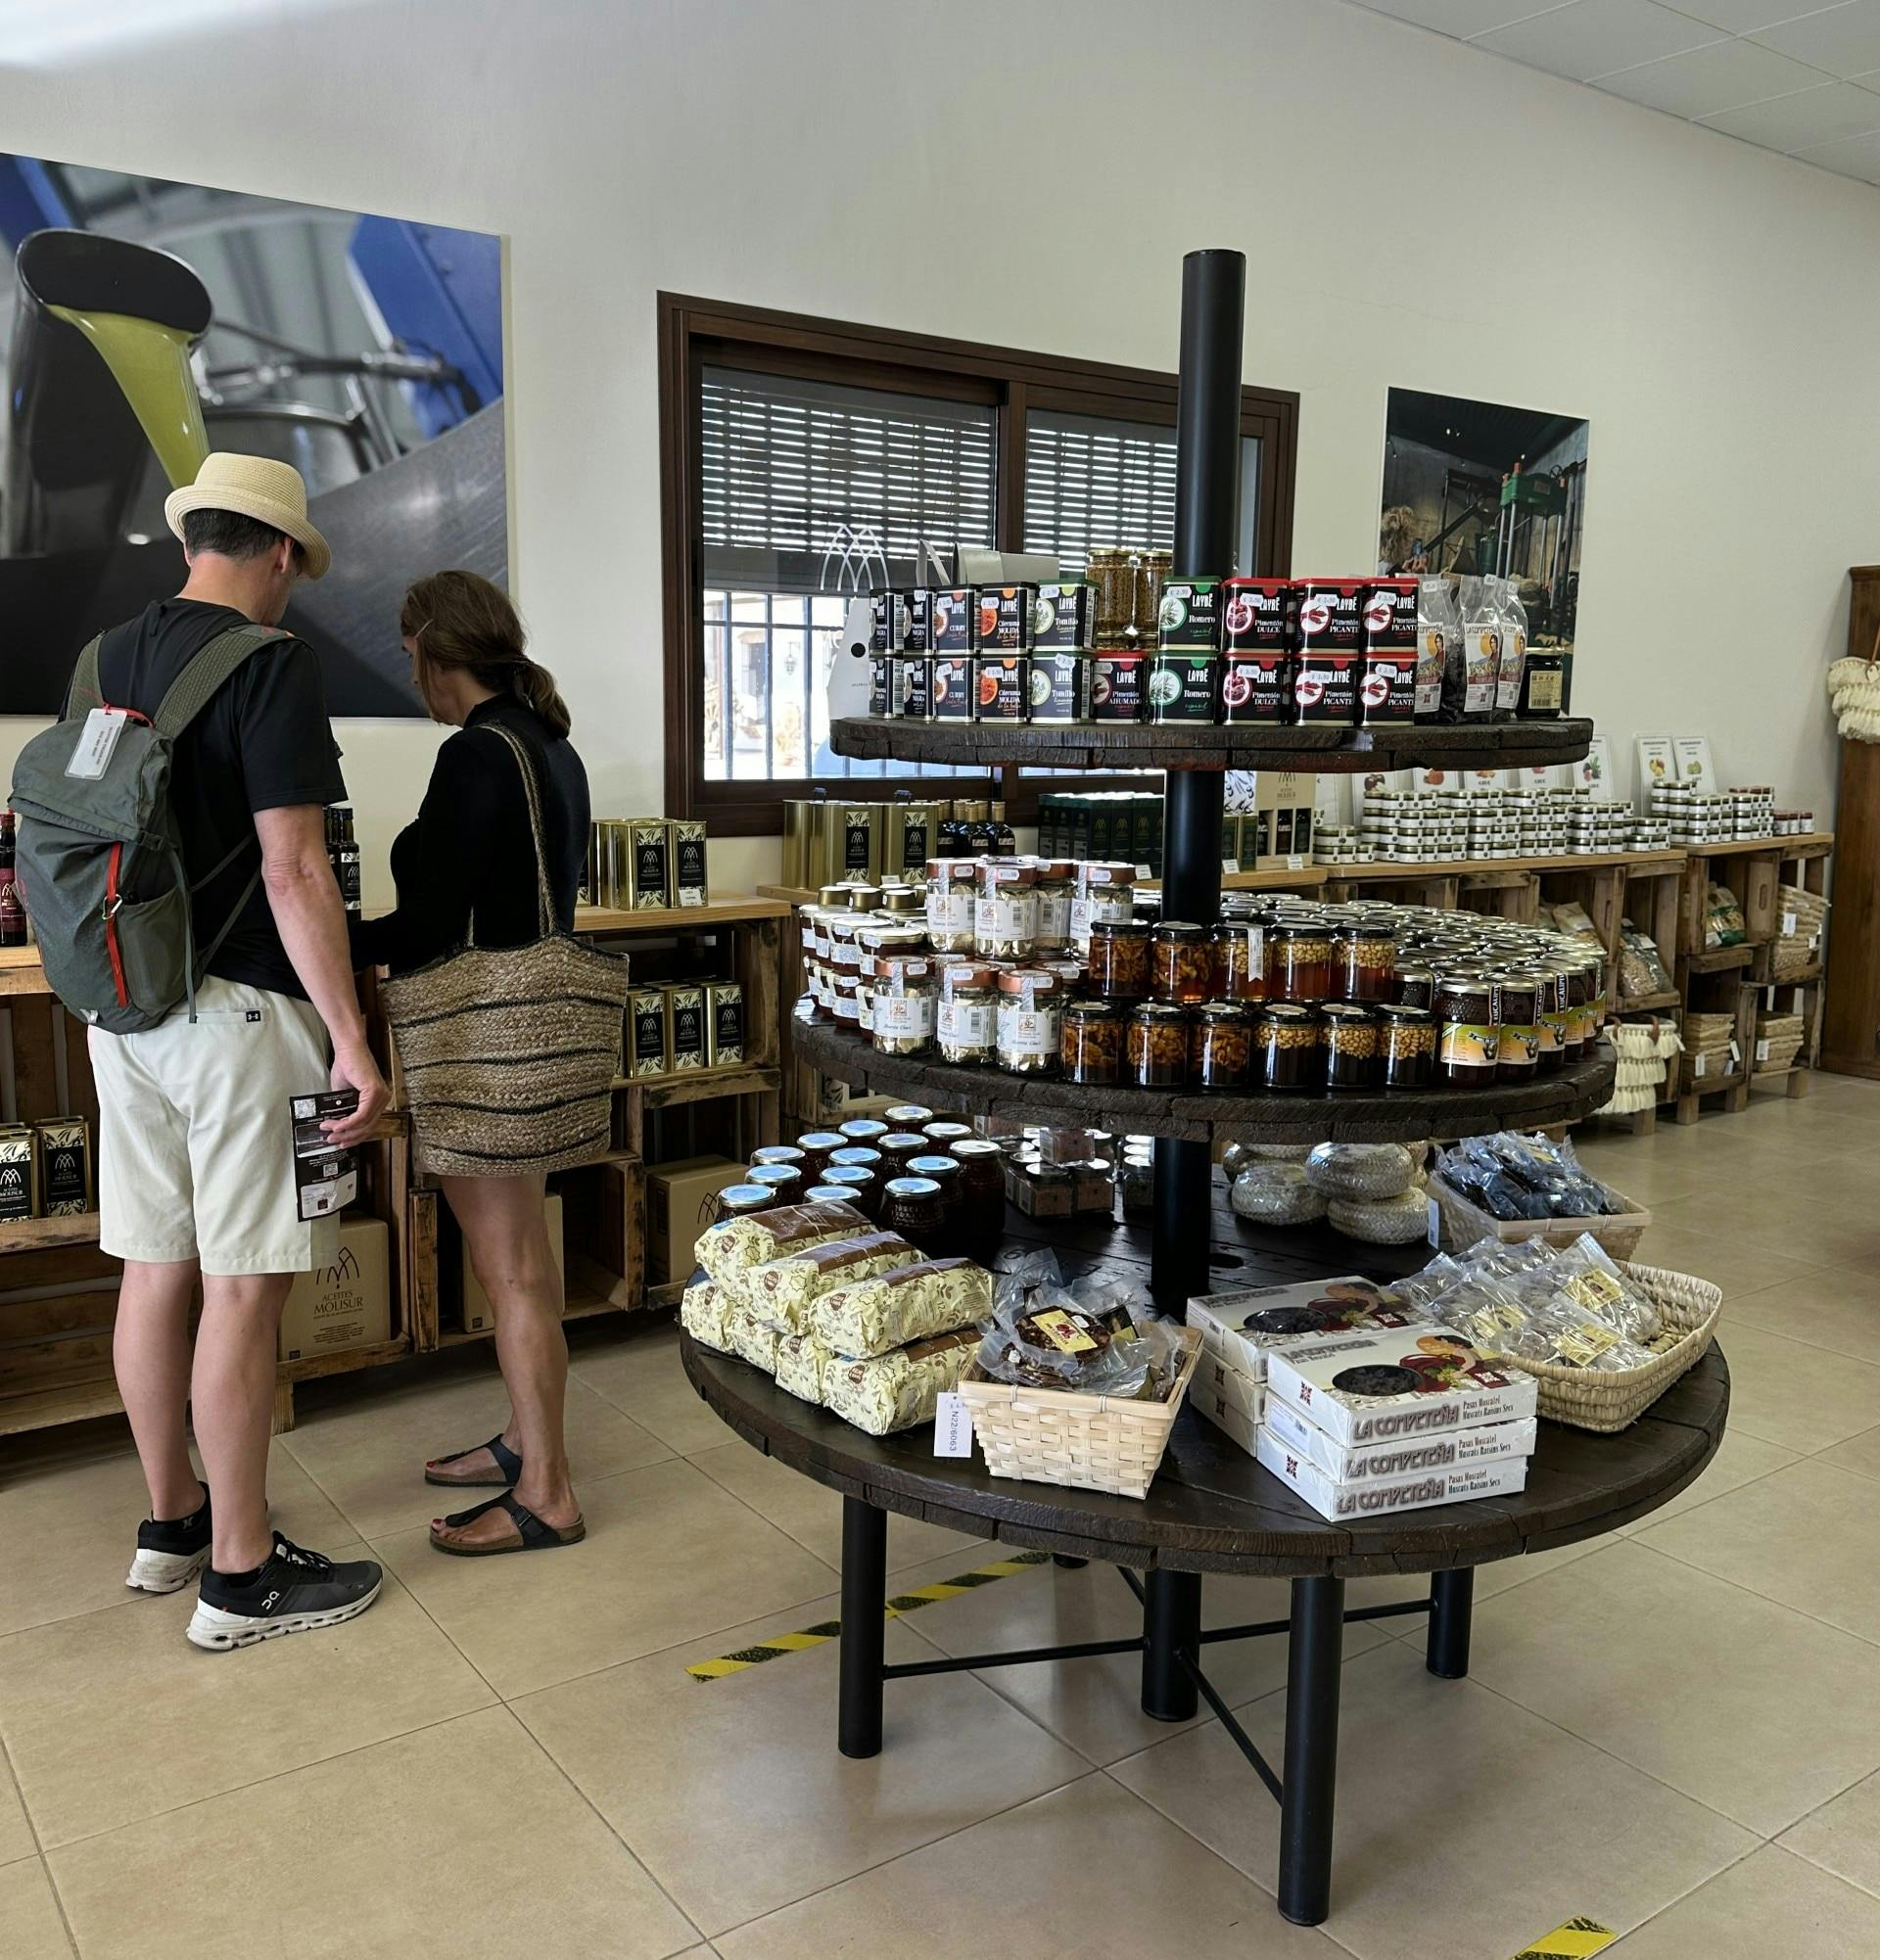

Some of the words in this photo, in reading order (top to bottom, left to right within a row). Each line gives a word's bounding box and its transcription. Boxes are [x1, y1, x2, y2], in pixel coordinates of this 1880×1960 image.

[1189, 615, 1216, 624] Romero
[323, 1291, 353, 1302] ACEITES
[314, 1296, 363, 1315] MOLISUR
[1463, 1400, 1478, 1410] Pasas
[1479, 1395, 1501, 1407] Moscatel
[950, 1411, 960, 1452] N22/6063
[1353, 1419, 1373, 1441] LA
[1458, 1439, 1474, 1449] Pasas
[1475, 1434, 1497, 1446] Moscatel
[1346, 1457, 1367, 1478] LA
[1449, 1474, 1464, 1484] Pasas
[1464, 1470, 1487, 1481] Moscatel
[1337, 1493, 1356, 1515] LA
